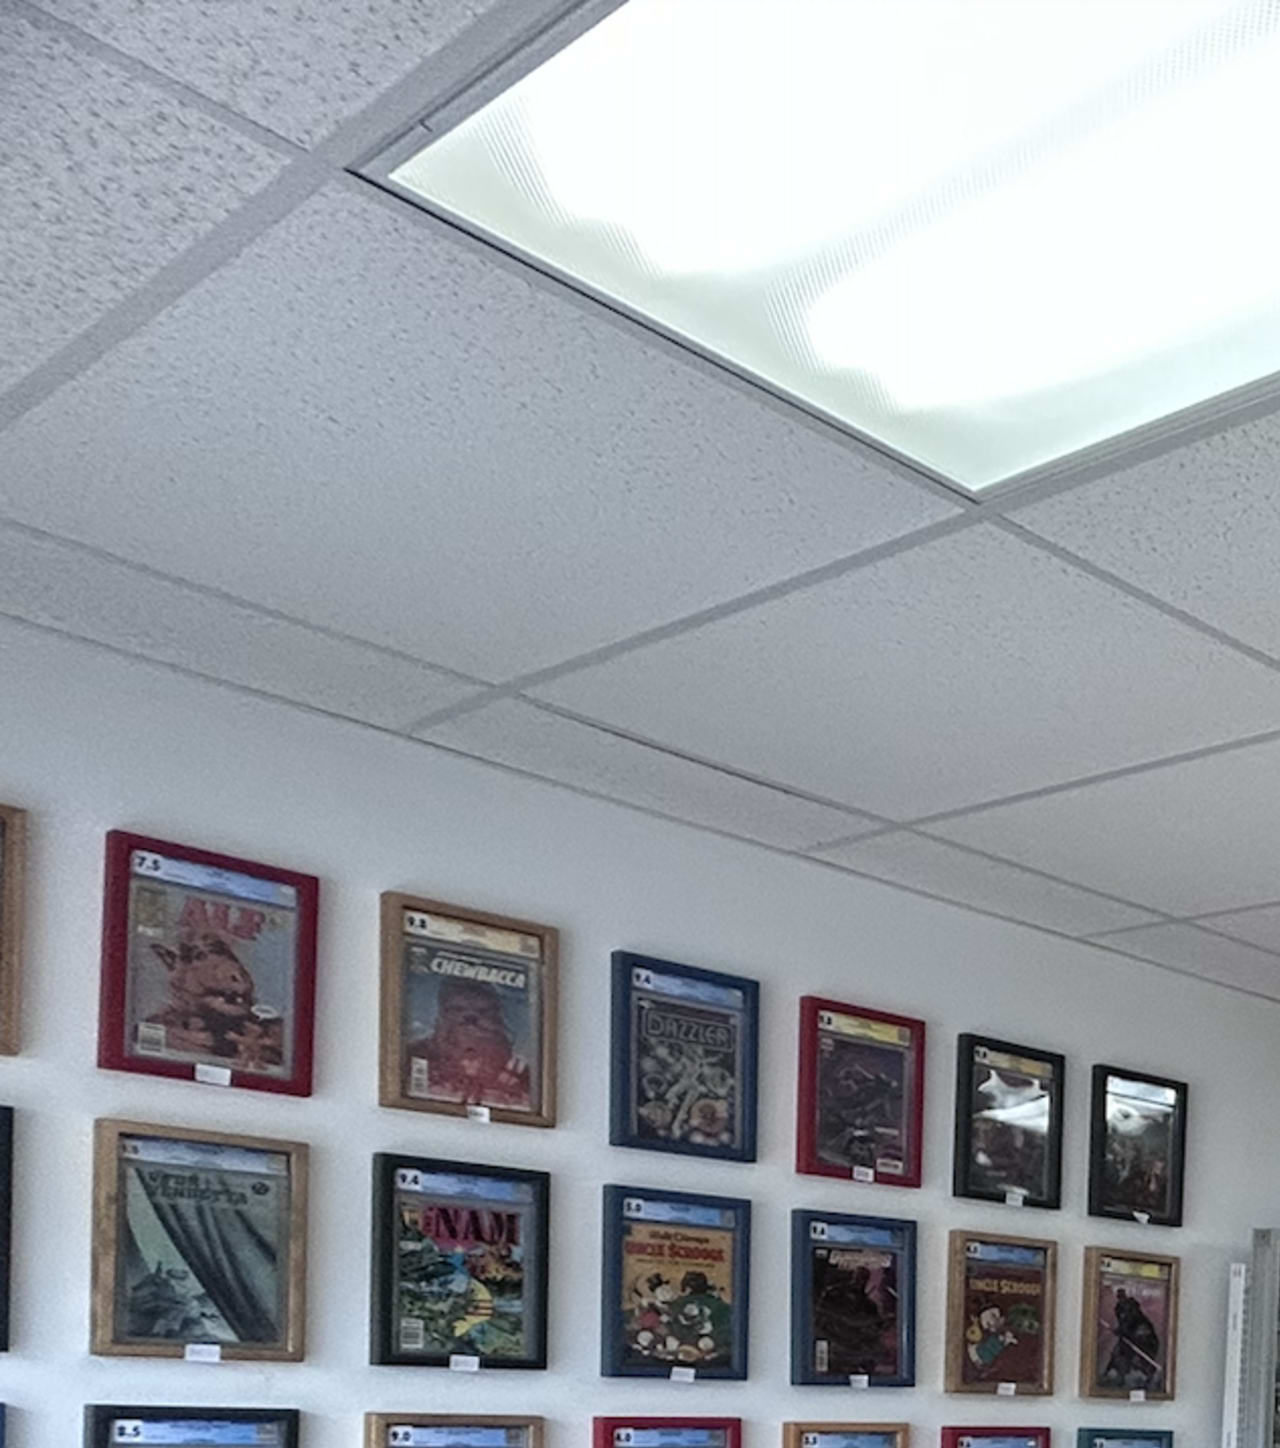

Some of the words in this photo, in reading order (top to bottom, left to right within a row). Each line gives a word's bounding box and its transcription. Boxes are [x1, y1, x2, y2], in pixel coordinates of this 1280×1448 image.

[135, 856, 161, 872] 7.5
[430, 956, 526, 988] CHEWBACCA
[648, 1012, 729, 1046] DAZZLER
[436, 1206, 520, 1246] NAM
